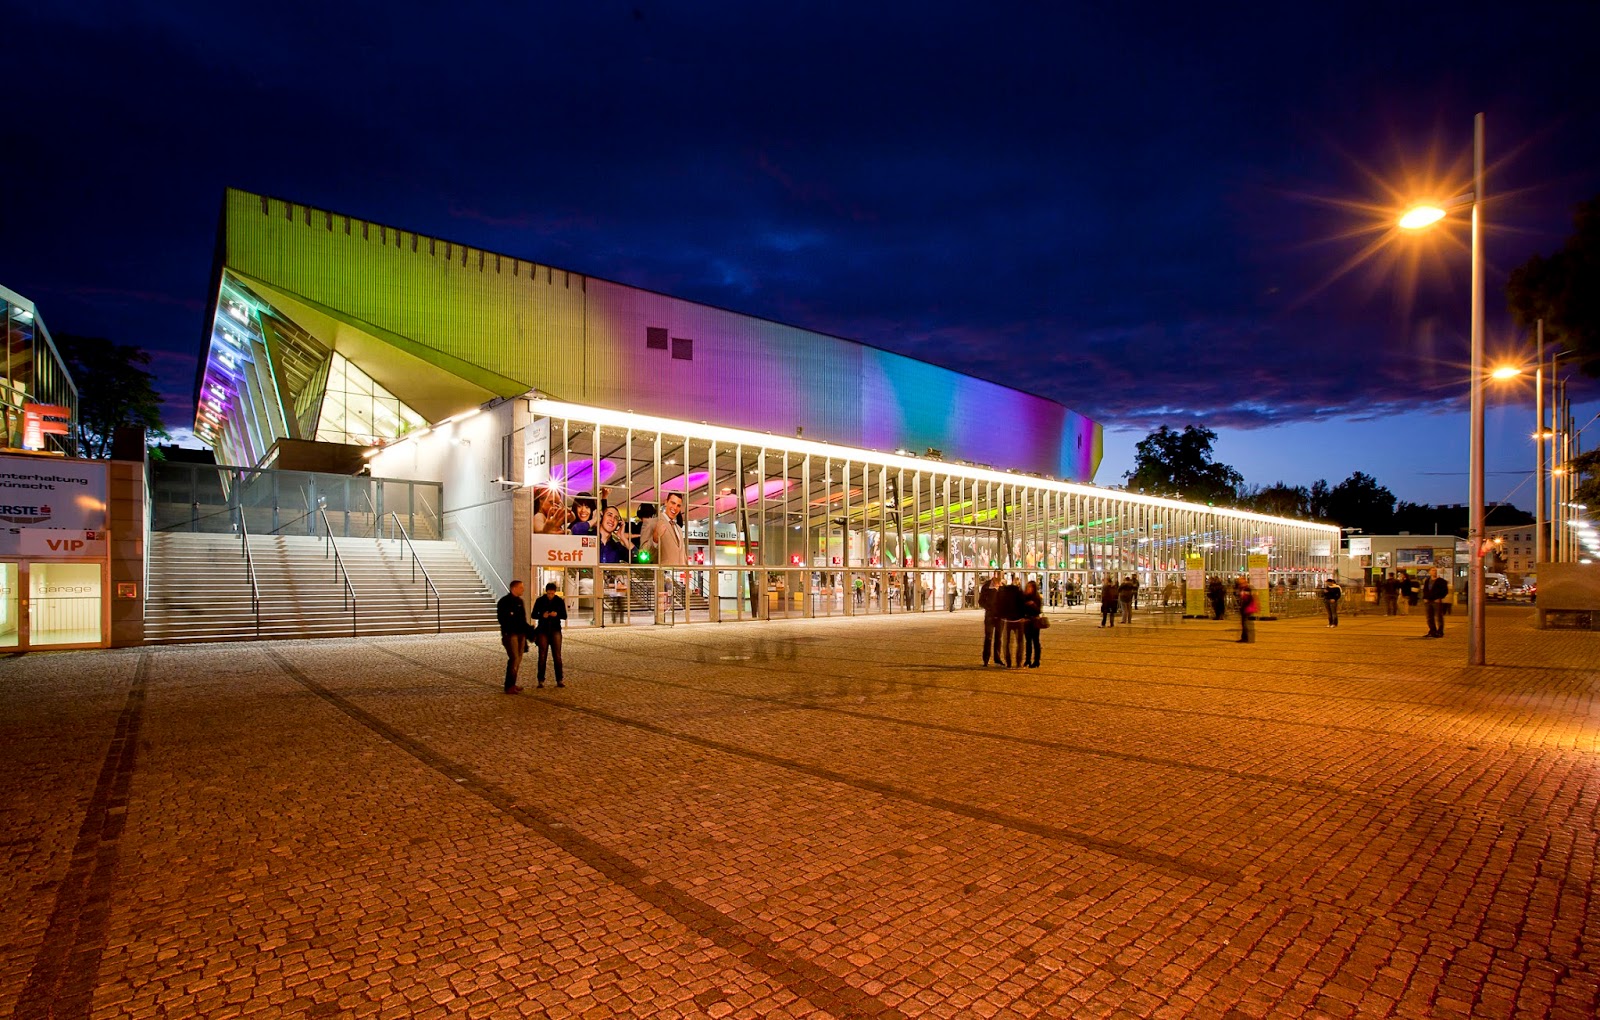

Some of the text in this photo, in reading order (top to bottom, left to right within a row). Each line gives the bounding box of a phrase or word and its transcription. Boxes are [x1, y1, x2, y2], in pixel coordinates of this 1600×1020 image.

[528, 450, 546, 468] süd
[0, 473, 88, 485] nterhaltung
[47, 539, 84, 551] VIP
[547, 549, 583, 561] Staff
[39, 586, 92, 594] garage
